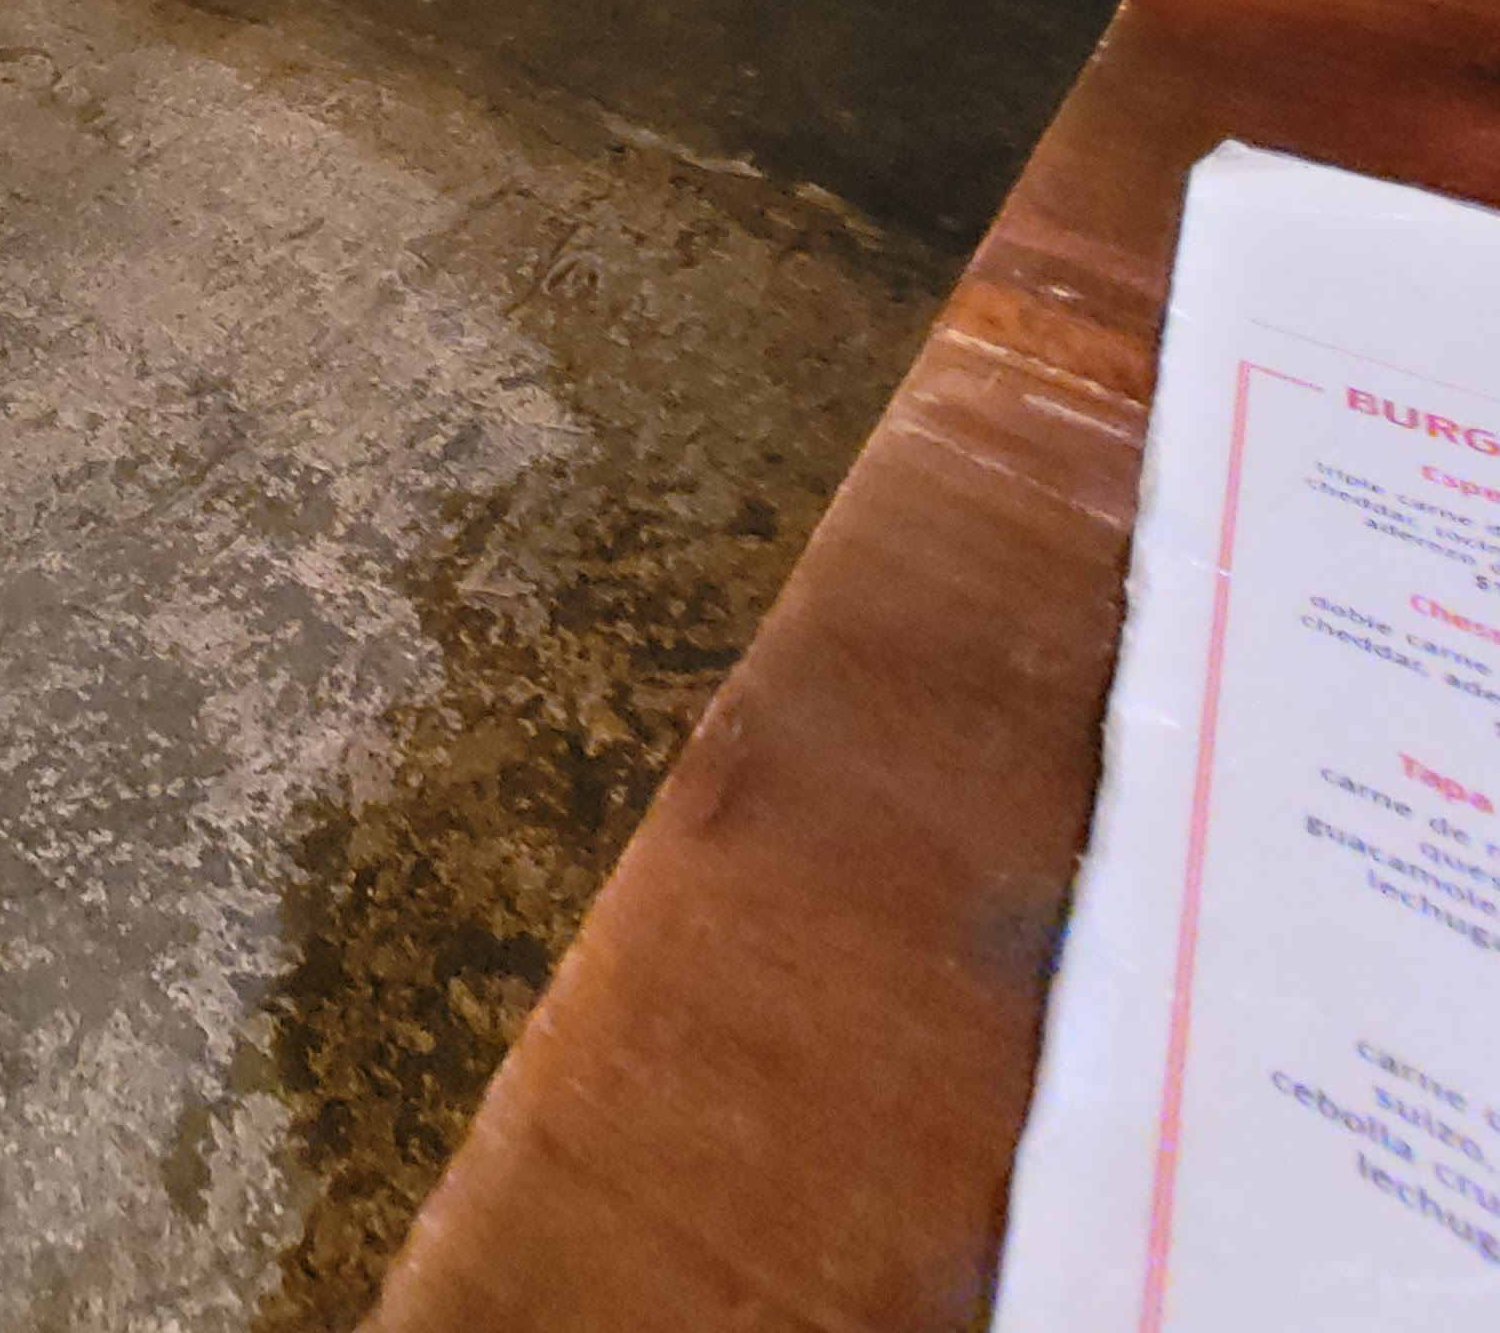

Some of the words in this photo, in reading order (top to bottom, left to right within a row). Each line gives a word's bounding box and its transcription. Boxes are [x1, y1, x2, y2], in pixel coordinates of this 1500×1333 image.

[1346, 386, 1500, 456] BURG
[1316, 461, 1386, 495] triple
[1398, 494, 1473, 526] carne
[1310, 595, 1393, 635] doble
[1406, 633, 1493, 677] carne
[1320, 767, 1413, 819] carne
[1428, 816, 1472, 846] de
[1356, 1039, 1468, 1114] carne
[1270, 1070, 1415, 1164] cebolla
